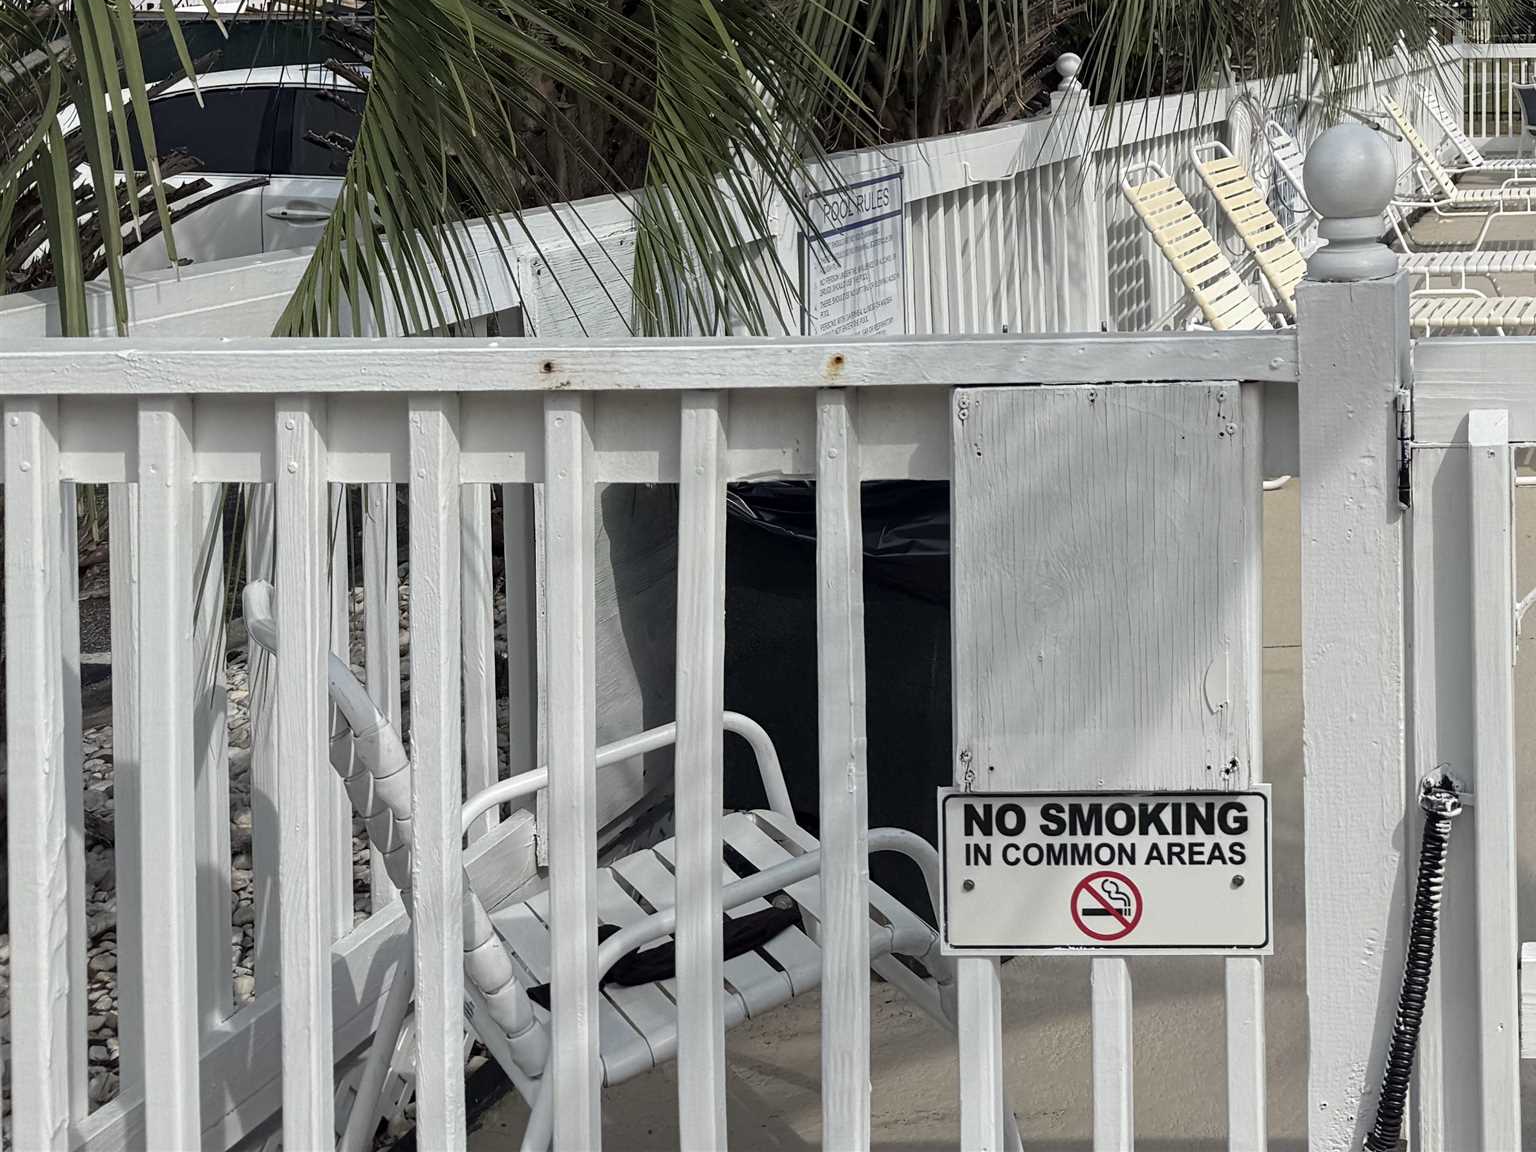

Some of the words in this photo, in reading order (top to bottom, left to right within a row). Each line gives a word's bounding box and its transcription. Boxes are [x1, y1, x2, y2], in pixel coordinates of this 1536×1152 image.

[823, 200, 854, 224] POOL
[856, 187, 889, 215] RULES
[963, 803, 1026, 837] NO
[1039, 801, 1249, 837] SMOKING
[965, 843, 992, 866] IN
[1001, 842, 1136, 866] COMMON
[1144, 841, 1247, 866] AREAS
